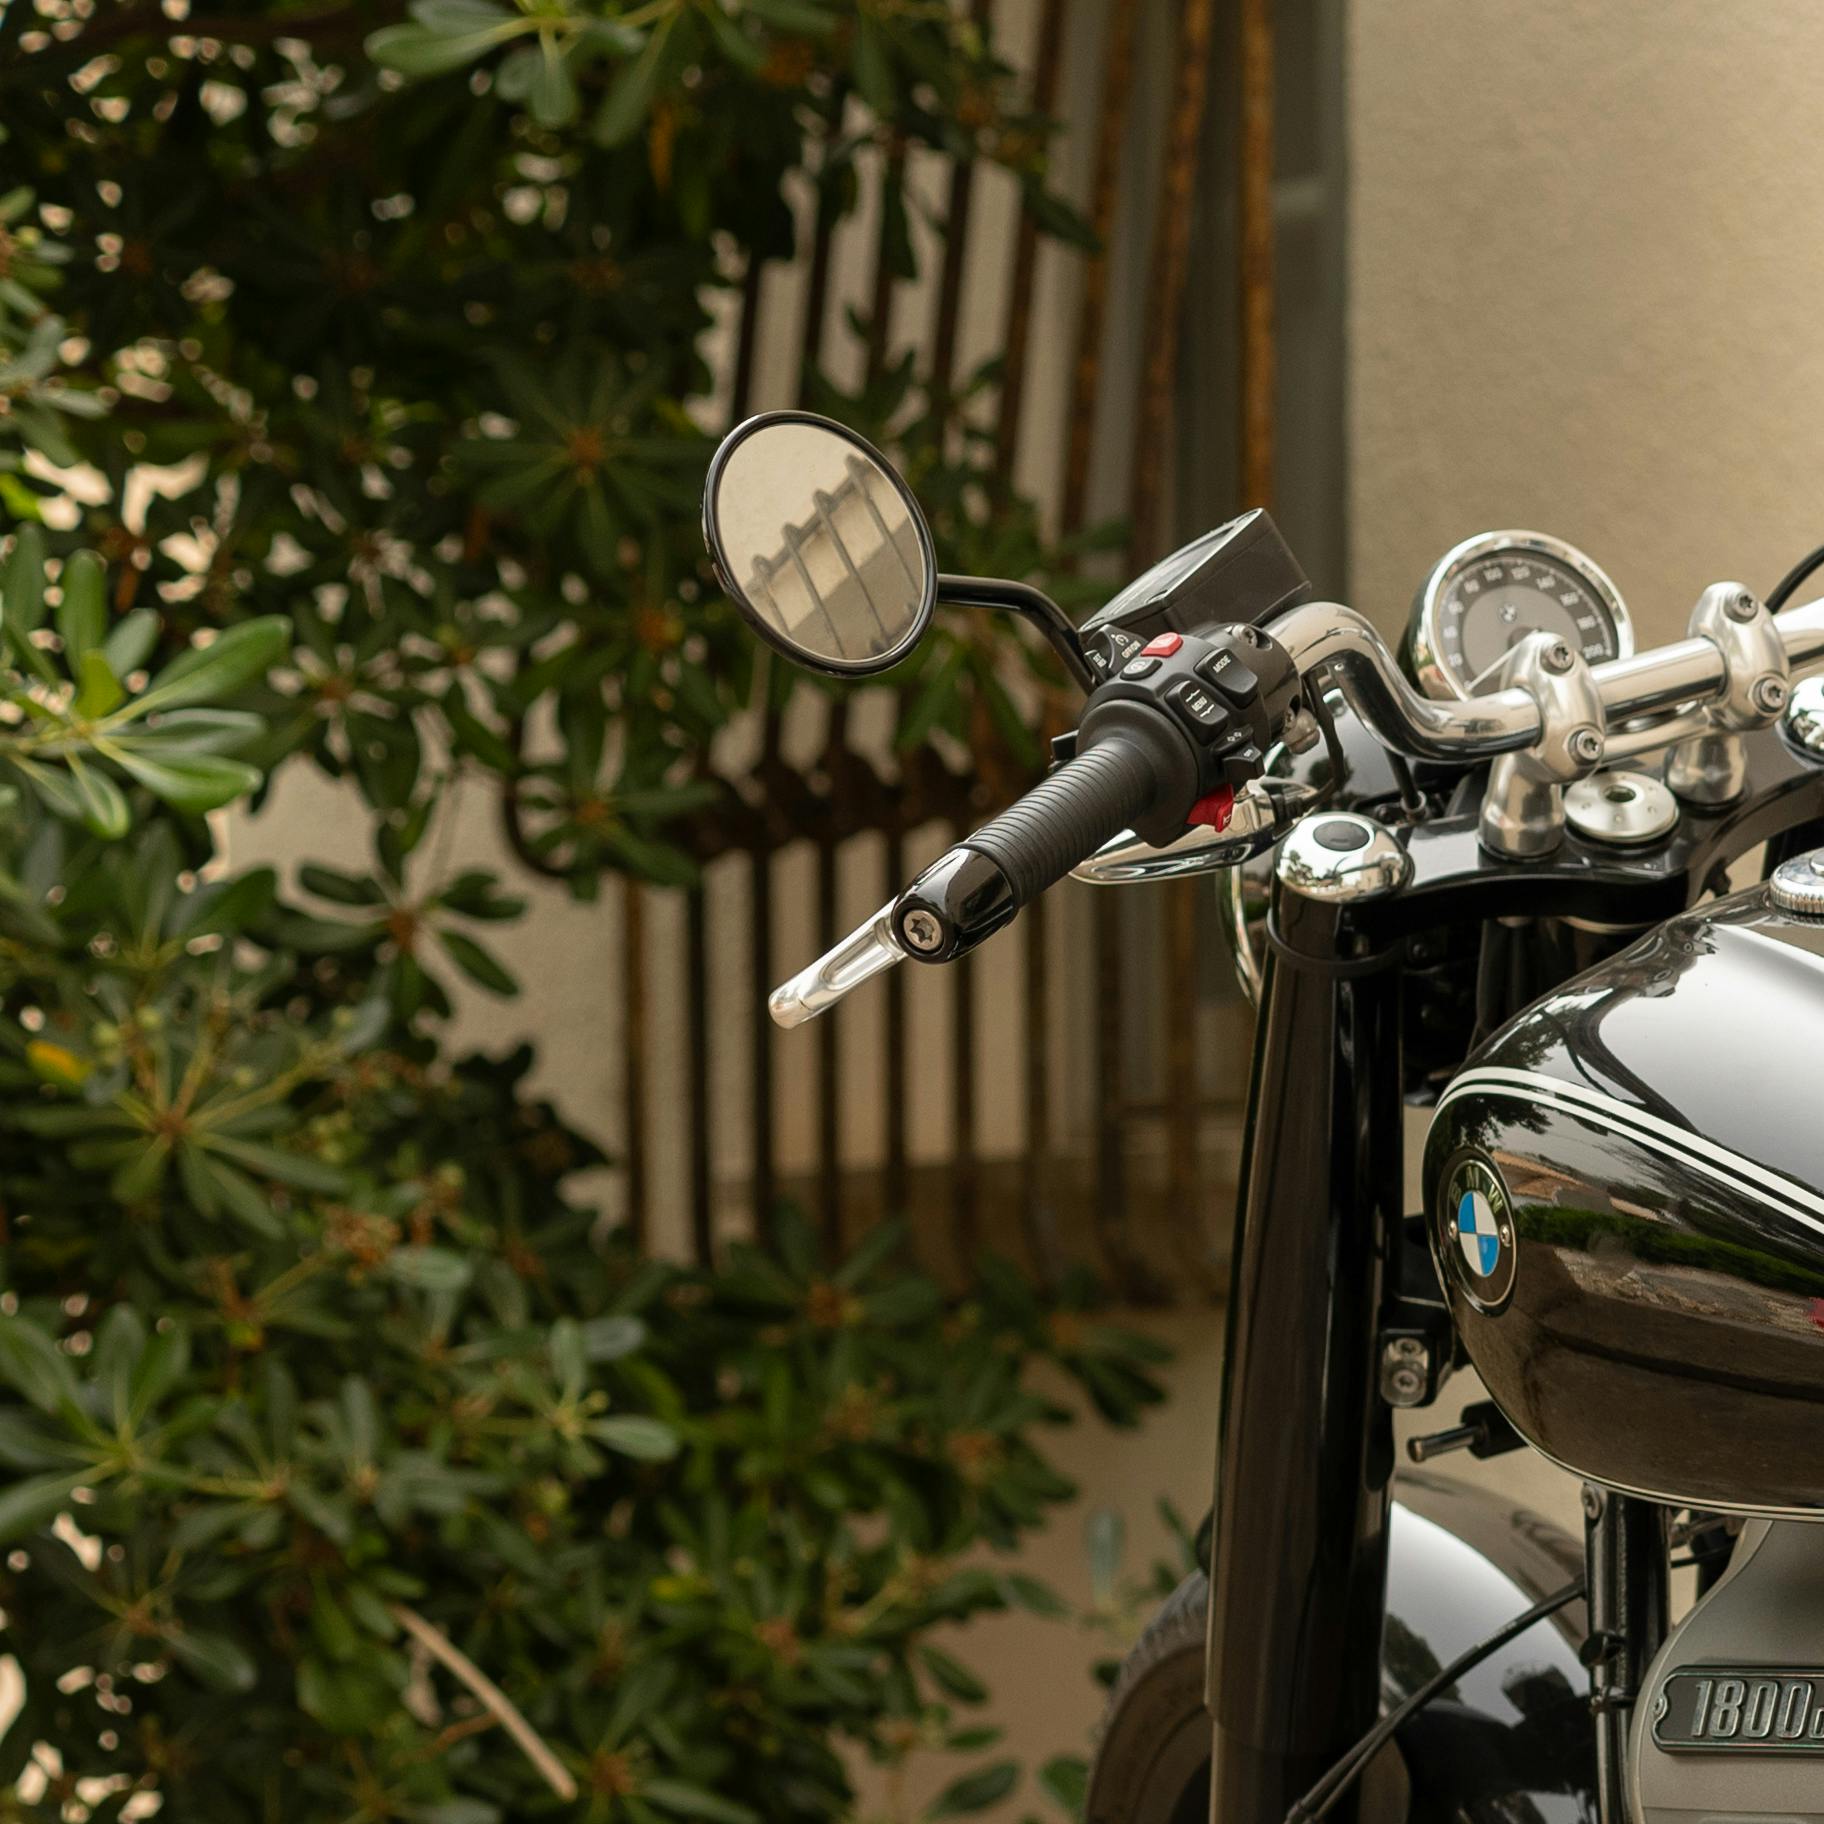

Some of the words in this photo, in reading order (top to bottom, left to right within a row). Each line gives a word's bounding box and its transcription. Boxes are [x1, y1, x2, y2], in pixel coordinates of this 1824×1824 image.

[1213, 655, 1232, 673] MODE
[1191, 696, 1208, 712] MENU
[1450, 1165, 1504, 1214] BMW
